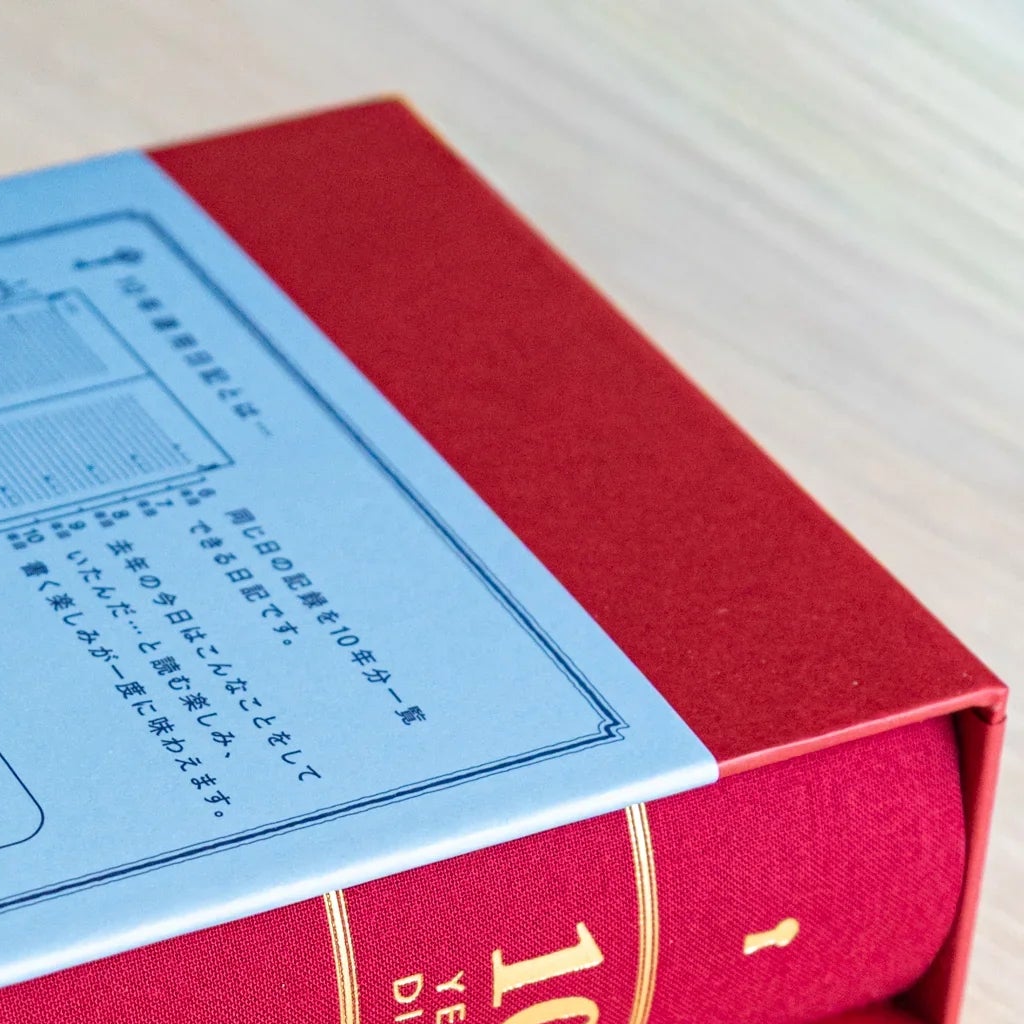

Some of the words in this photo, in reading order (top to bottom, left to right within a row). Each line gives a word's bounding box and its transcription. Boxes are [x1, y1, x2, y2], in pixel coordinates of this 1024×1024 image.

[20, 560, 230, 817] 書く楽しみが一度に味わえます。
[106, 540, 321, 781] 去年の今日はこんなことをして
[189, 520, 298, 645] できる日記です。
[225, 508, 426, 725] 同じ日の記録を10年分一覧
